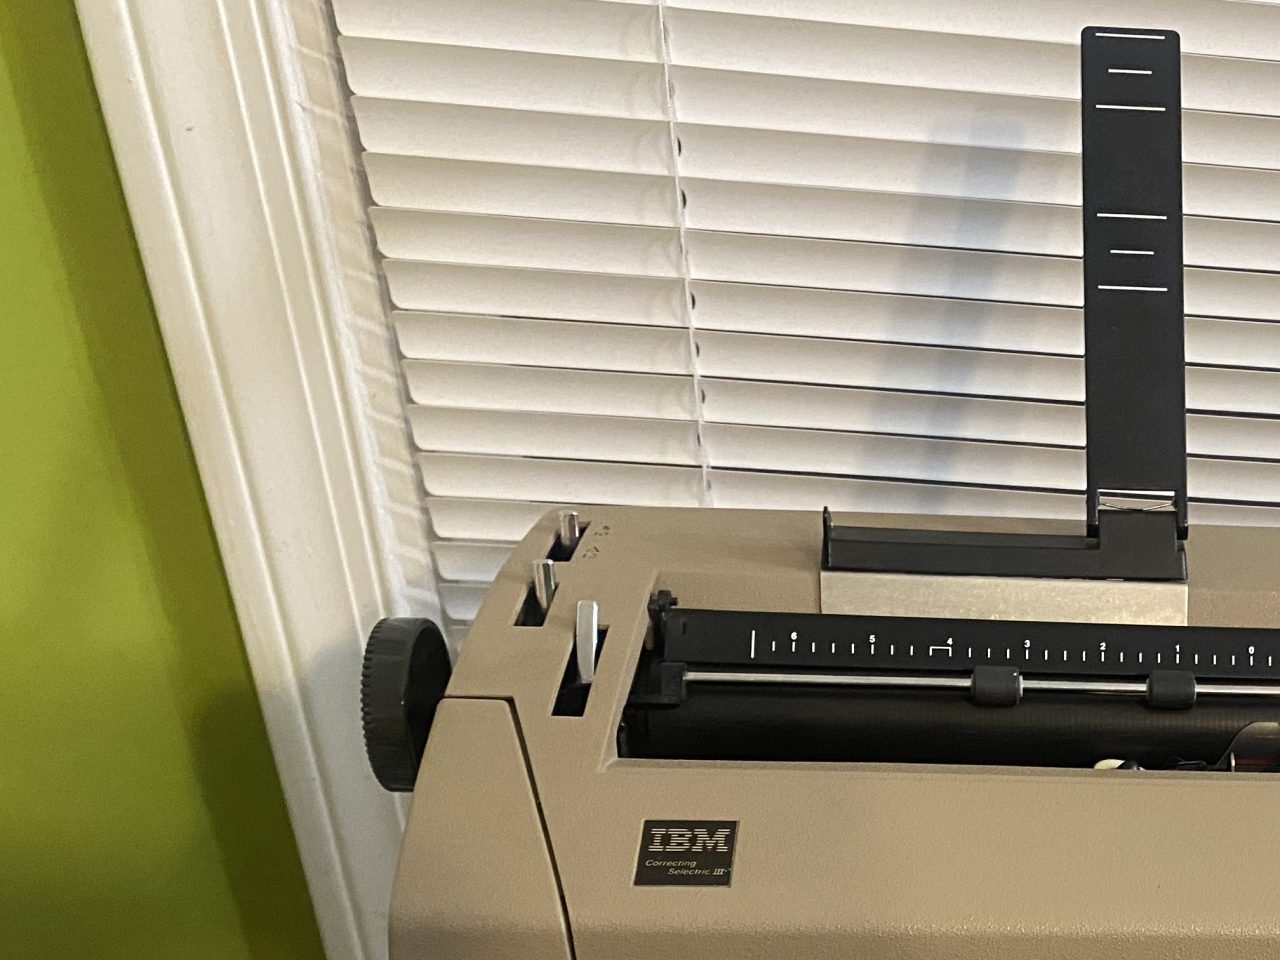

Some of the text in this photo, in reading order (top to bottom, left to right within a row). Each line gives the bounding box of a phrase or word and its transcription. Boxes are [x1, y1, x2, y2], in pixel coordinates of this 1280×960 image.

[790, 632, 798, 641] 6
[869, 635, 876, 643] 5
[946, 638, 953, 646] 4
[1024, 640, 1031, 648] 3
[1099, 643, 1107, 651] 2
[1175, 645, 1180, 653] 1
[1248, 646, 1255, 655] 0
[648, 828, 732, 851] IBM
[645, 859, 697, 867] Correcting
[667, 868, 711, 876] Selectric
